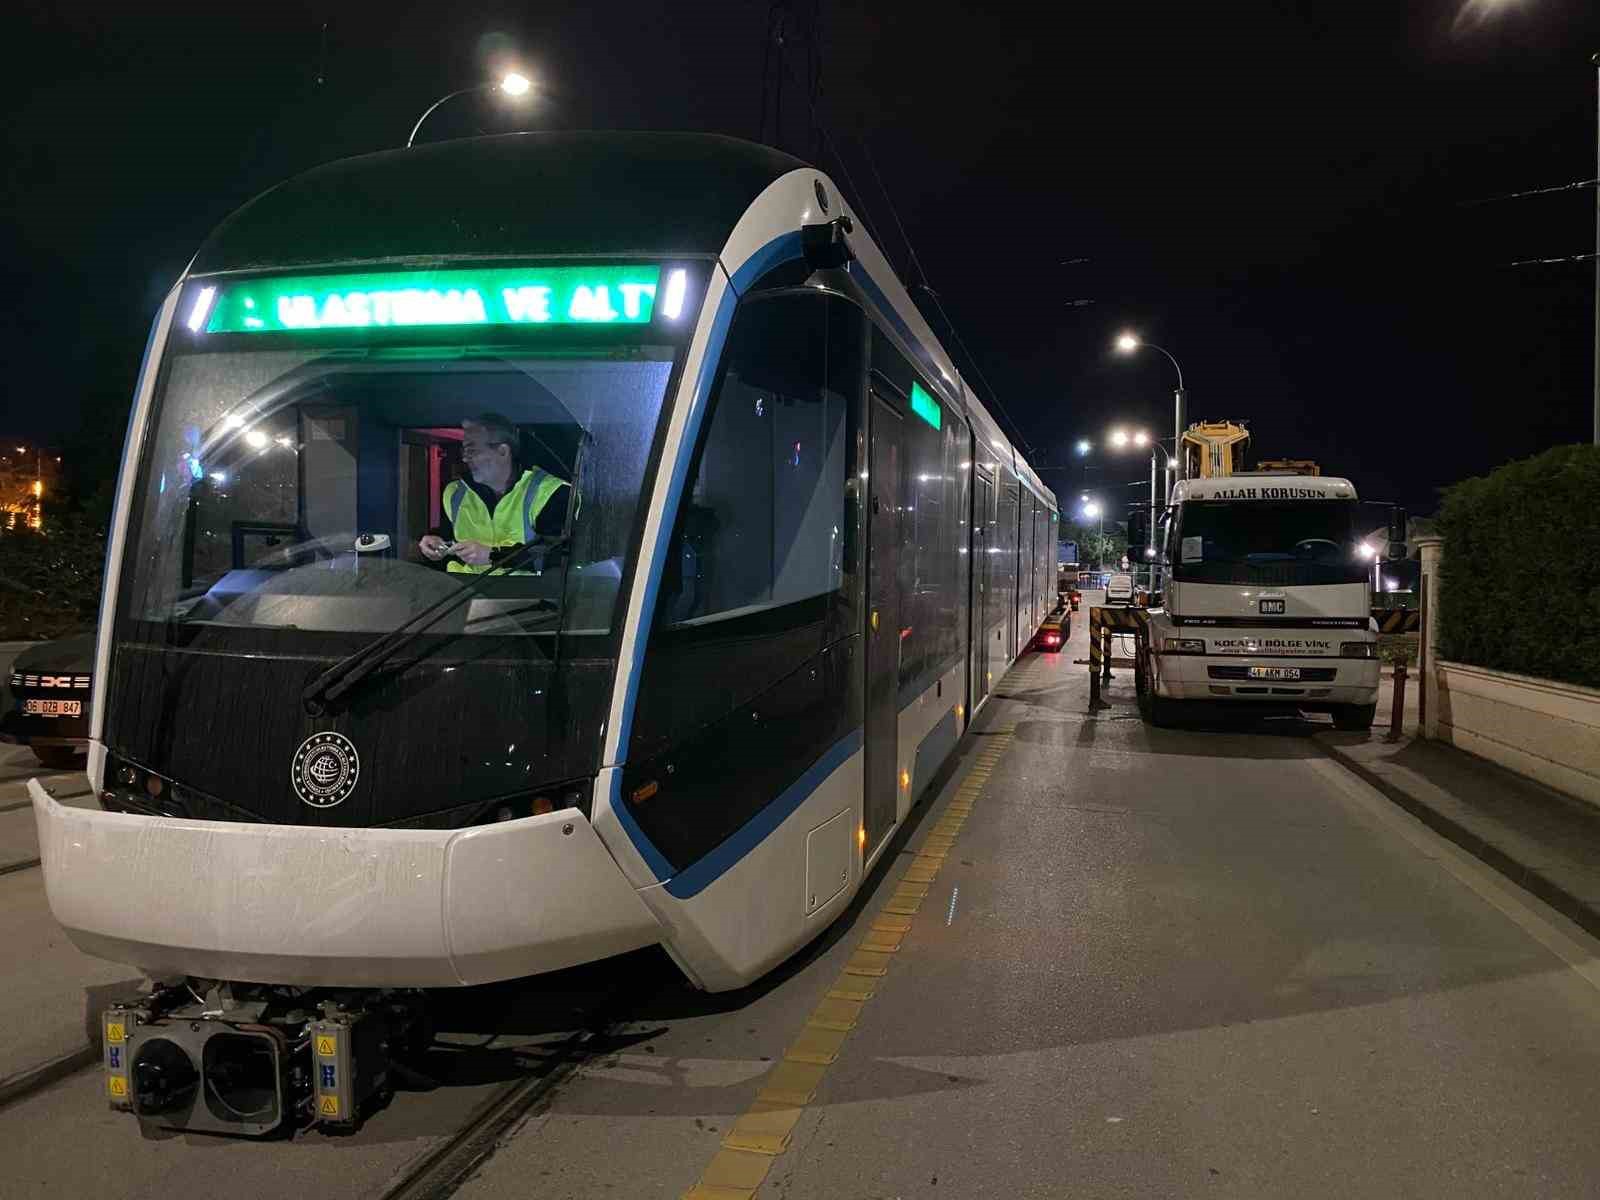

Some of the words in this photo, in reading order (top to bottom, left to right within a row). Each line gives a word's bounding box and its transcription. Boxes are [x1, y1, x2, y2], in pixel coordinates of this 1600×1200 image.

[502, 285, 551, 321] VE
[1214, 488, 1257, 499] ALLAH
[1261, 487, 1326, 498] KORUSUN
[26, 701, 37, 711] 06
[63, 702, 79, 713] 847
